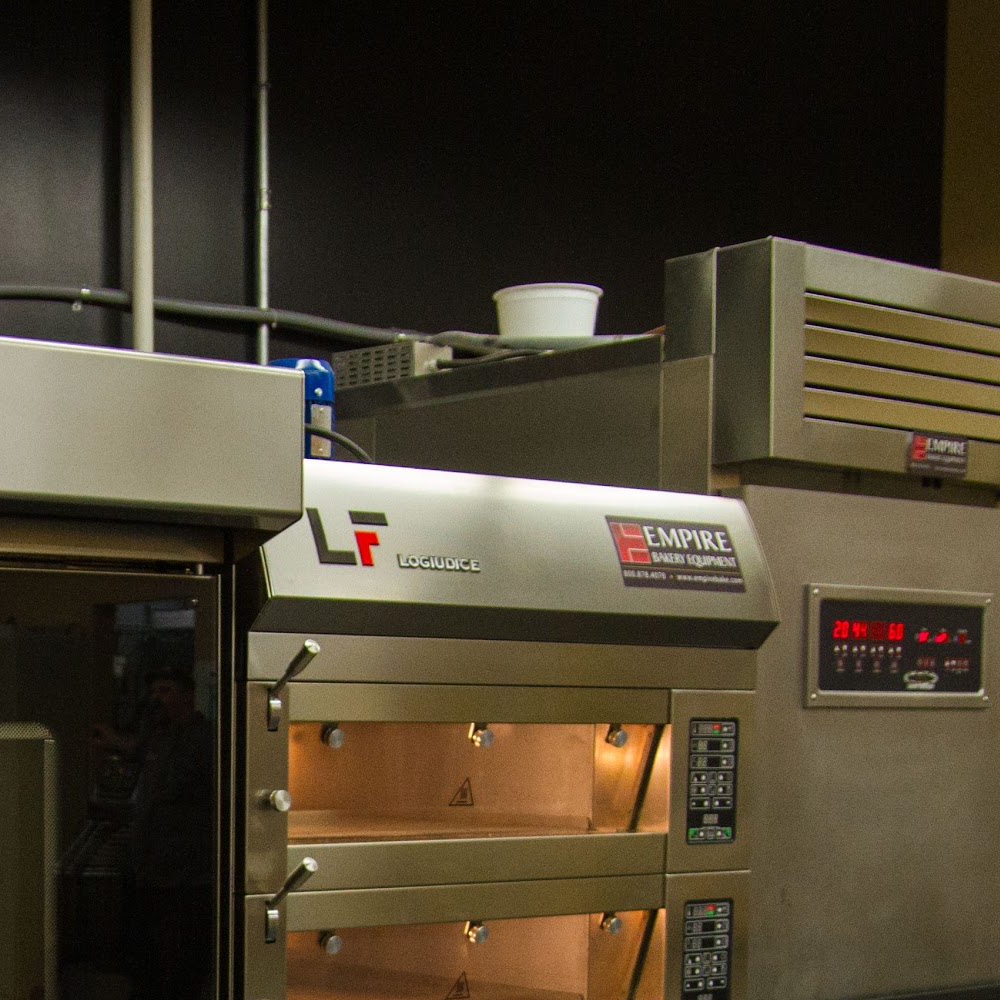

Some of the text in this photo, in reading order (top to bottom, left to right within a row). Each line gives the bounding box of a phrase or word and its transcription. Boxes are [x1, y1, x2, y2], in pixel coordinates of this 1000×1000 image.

[643, 526, 732, 552] EMPIRE
[397, 554, 481, 573] LOGIUDICE
[651, 551, 737, 569] BAKERY EQUIPMENT
